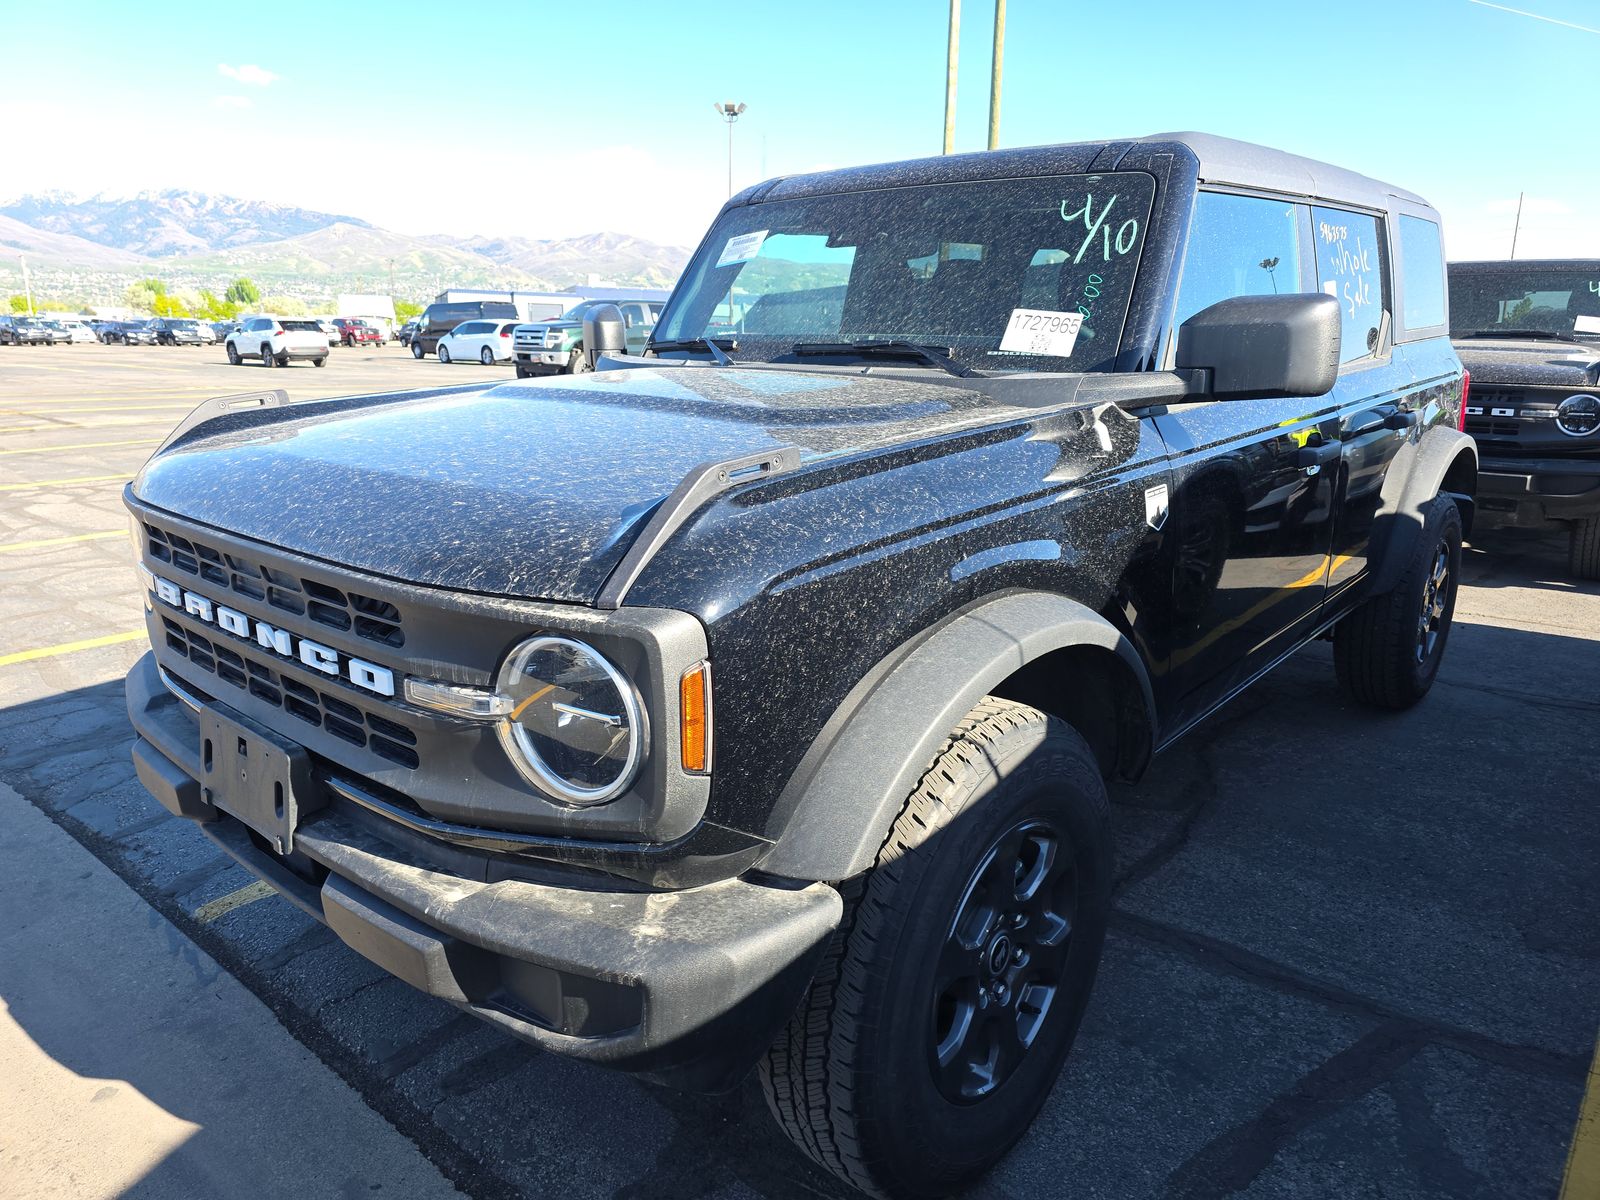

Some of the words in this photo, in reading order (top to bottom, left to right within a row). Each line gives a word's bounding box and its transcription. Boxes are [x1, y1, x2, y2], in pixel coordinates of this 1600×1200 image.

[1060, 193, 1138, 264] 4/10
[1013, 313, 1080, 334] 1727965
[155, 577, 395, 696] BRONCO
